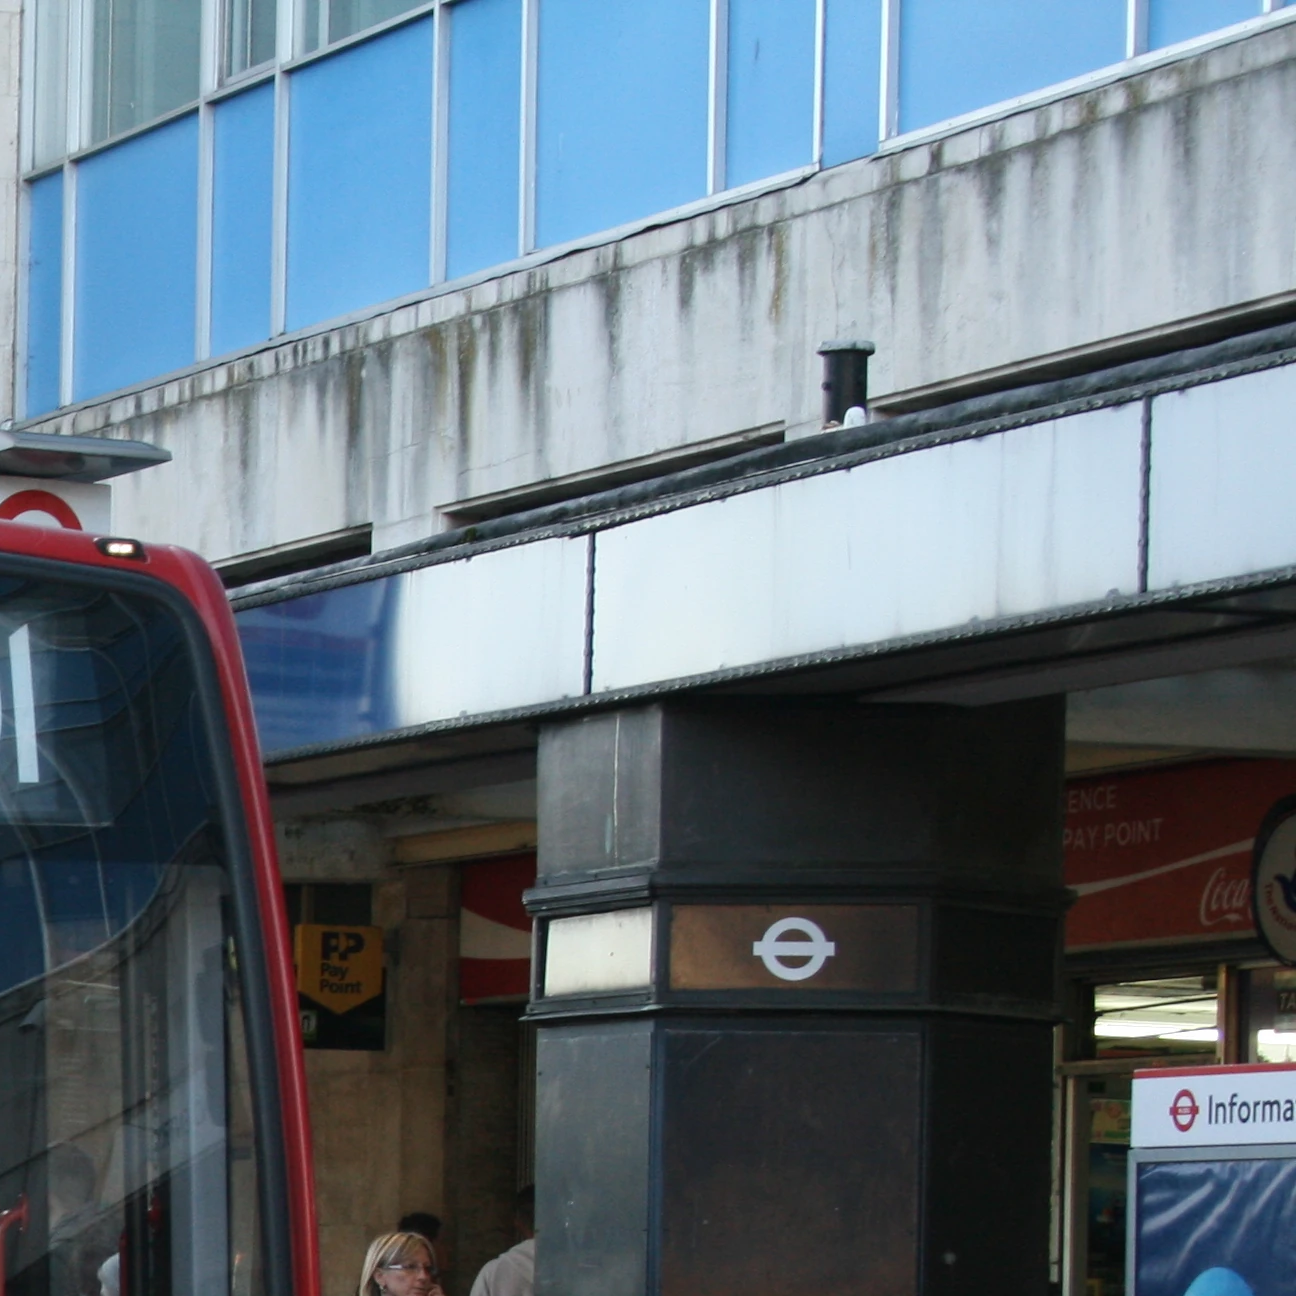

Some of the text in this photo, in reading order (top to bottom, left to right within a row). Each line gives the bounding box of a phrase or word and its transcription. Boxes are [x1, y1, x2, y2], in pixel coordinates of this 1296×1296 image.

[1065, 785, 1117, 813] ENCE
[1062, 817, 1165, 851] PAY POINT
[321, 963, 349, 981] Pay
[319, 979, 363, 994] Point
[1208, 1093, 1296, 1125] Informa
